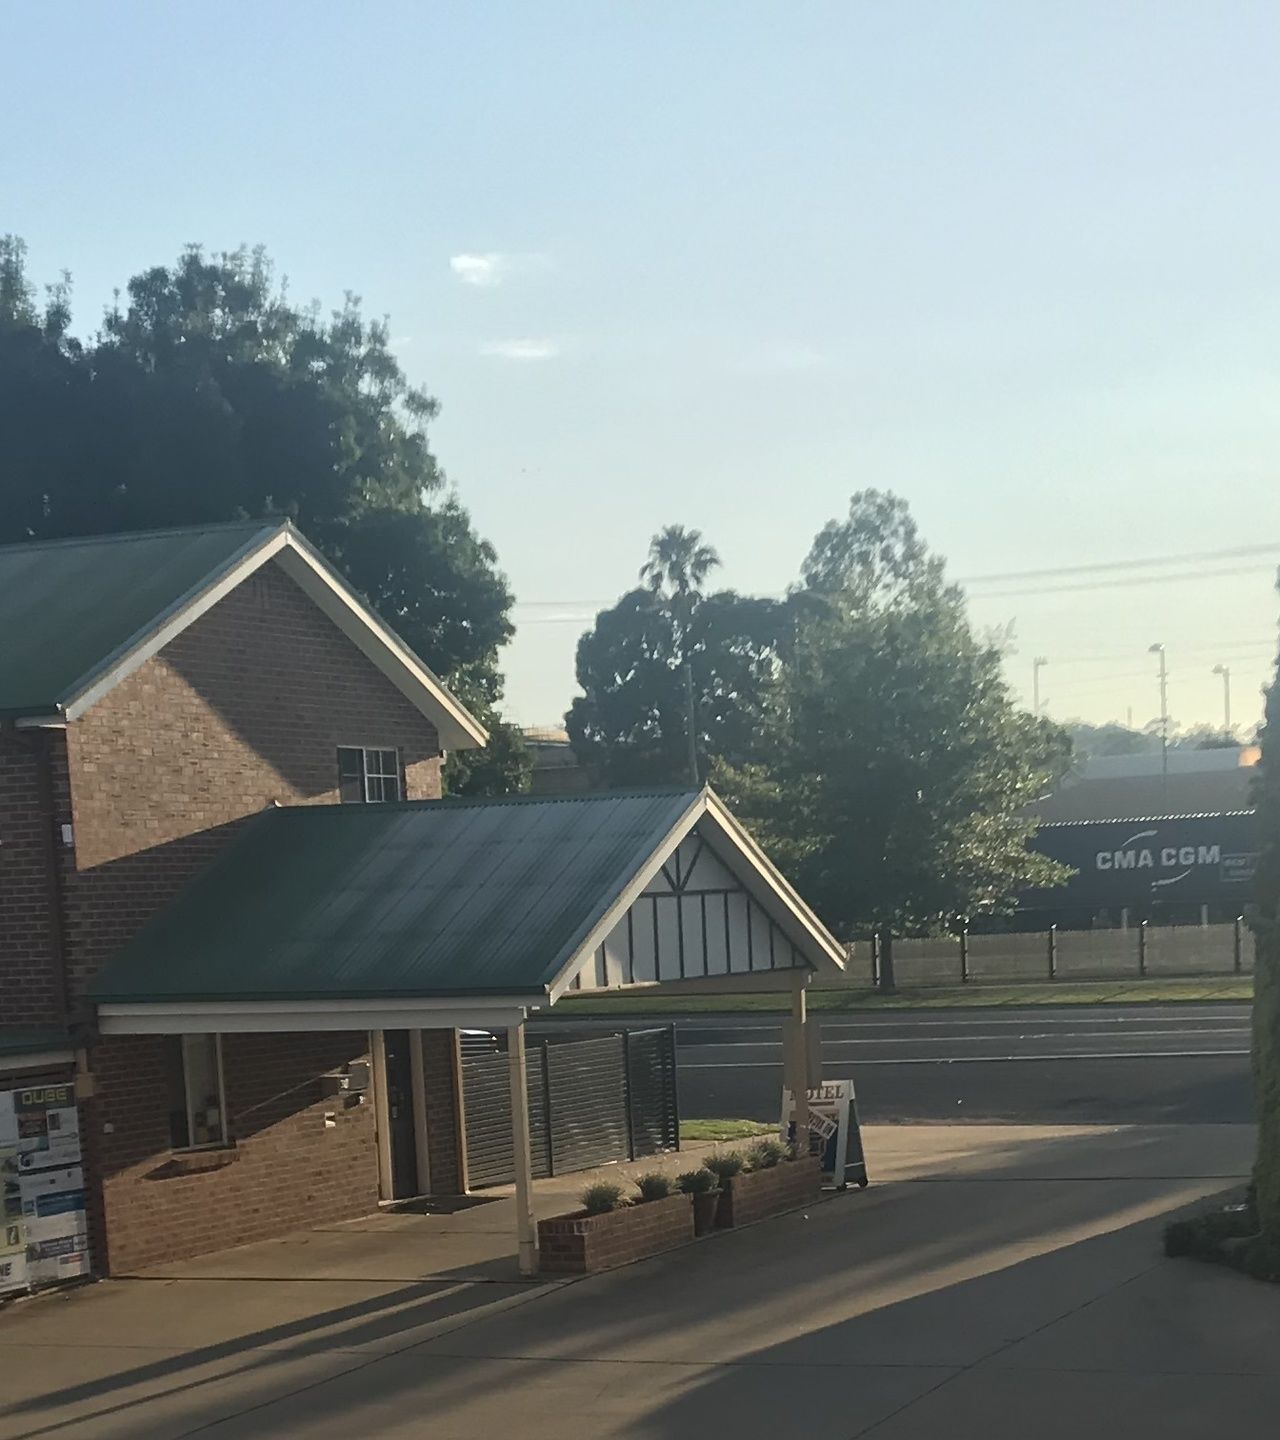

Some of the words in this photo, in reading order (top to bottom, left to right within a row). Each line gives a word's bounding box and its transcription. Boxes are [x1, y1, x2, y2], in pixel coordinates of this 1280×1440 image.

[1095, 848, 1153, 870] CMA
[1160, 845, 1222, 867] CGM
[21, 1088, 67, 1105] QUBE
